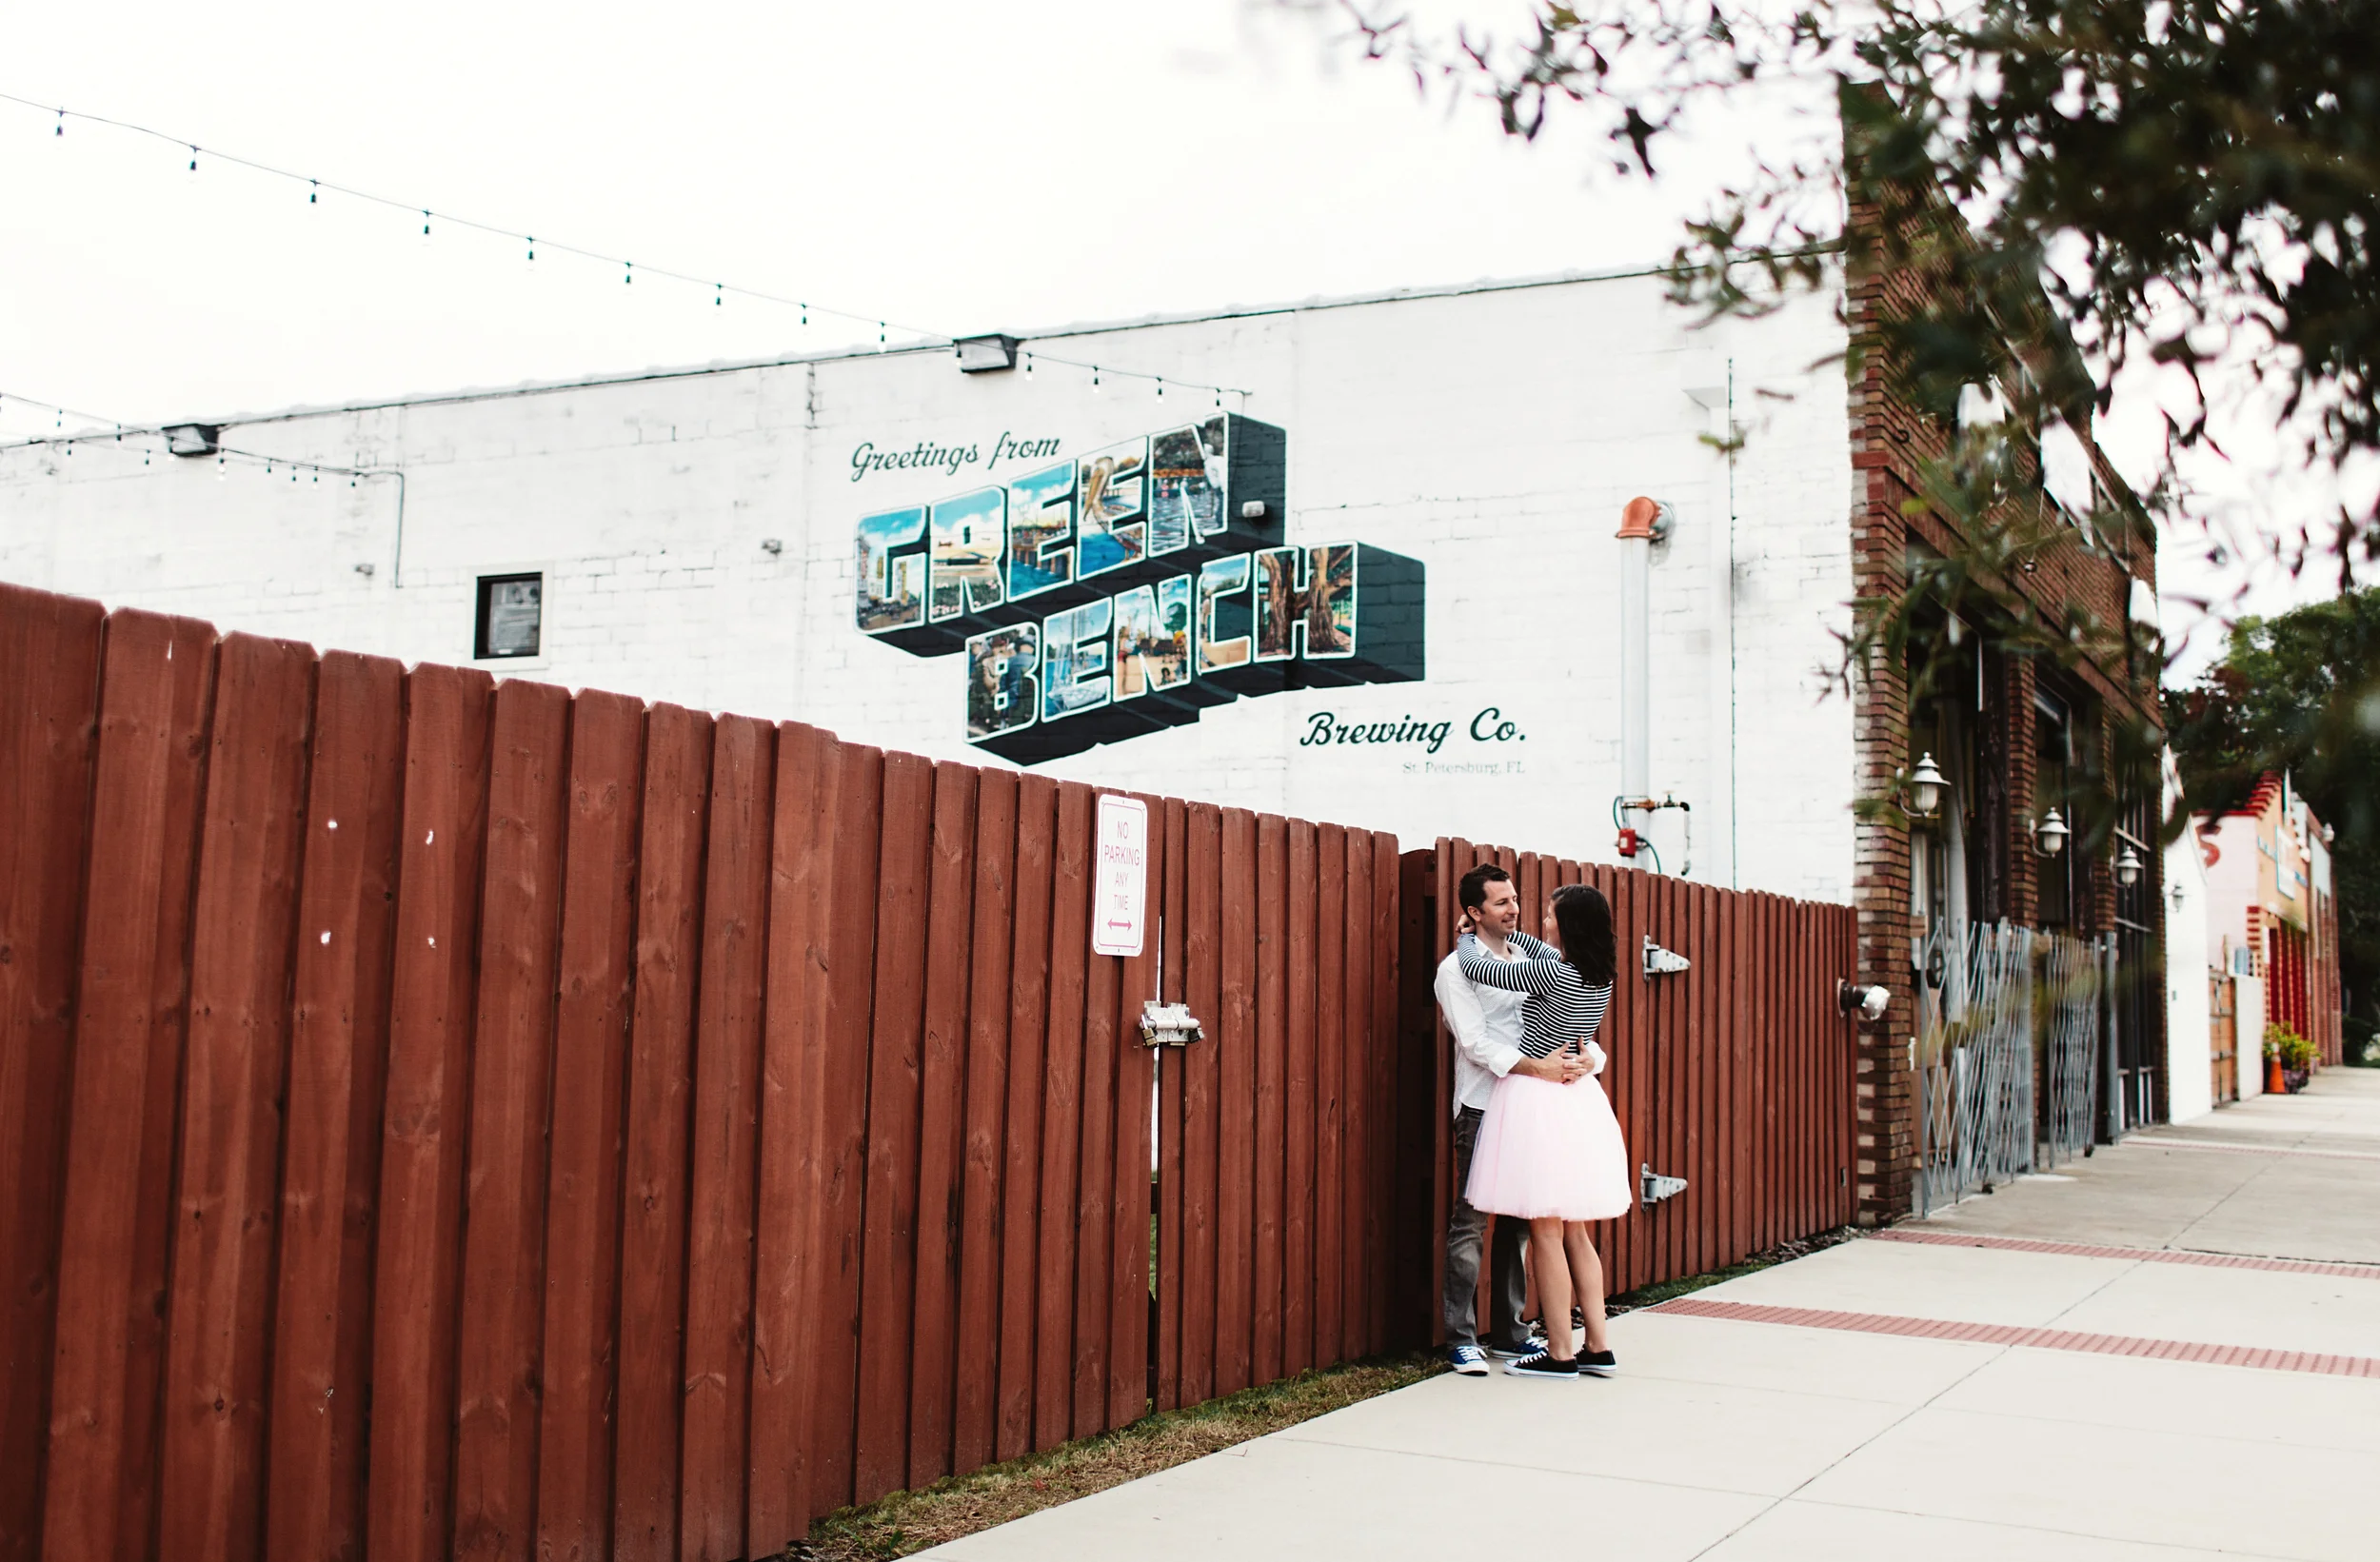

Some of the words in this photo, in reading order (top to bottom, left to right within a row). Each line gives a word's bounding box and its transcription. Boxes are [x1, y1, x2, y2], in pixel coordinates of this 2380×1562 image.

[851, 442, 982, 482] Greetings
[987, 430, 1061, 470] from
[854, 411, 1231, 636] GREEN
[963, 540, 1359, 744] BENCH
[1299, 711, 1453, 754] Brewing
[1469, 707, 1526, 741] Co.
[1506, 761, 1525, 775] FL
[1116, 821, 1129, 840] NO
[1104, 844, 1140, 866] PARKING
[1114, 871, 1129, 888] ANY
[1113, 894, 1129, 911] TIME
